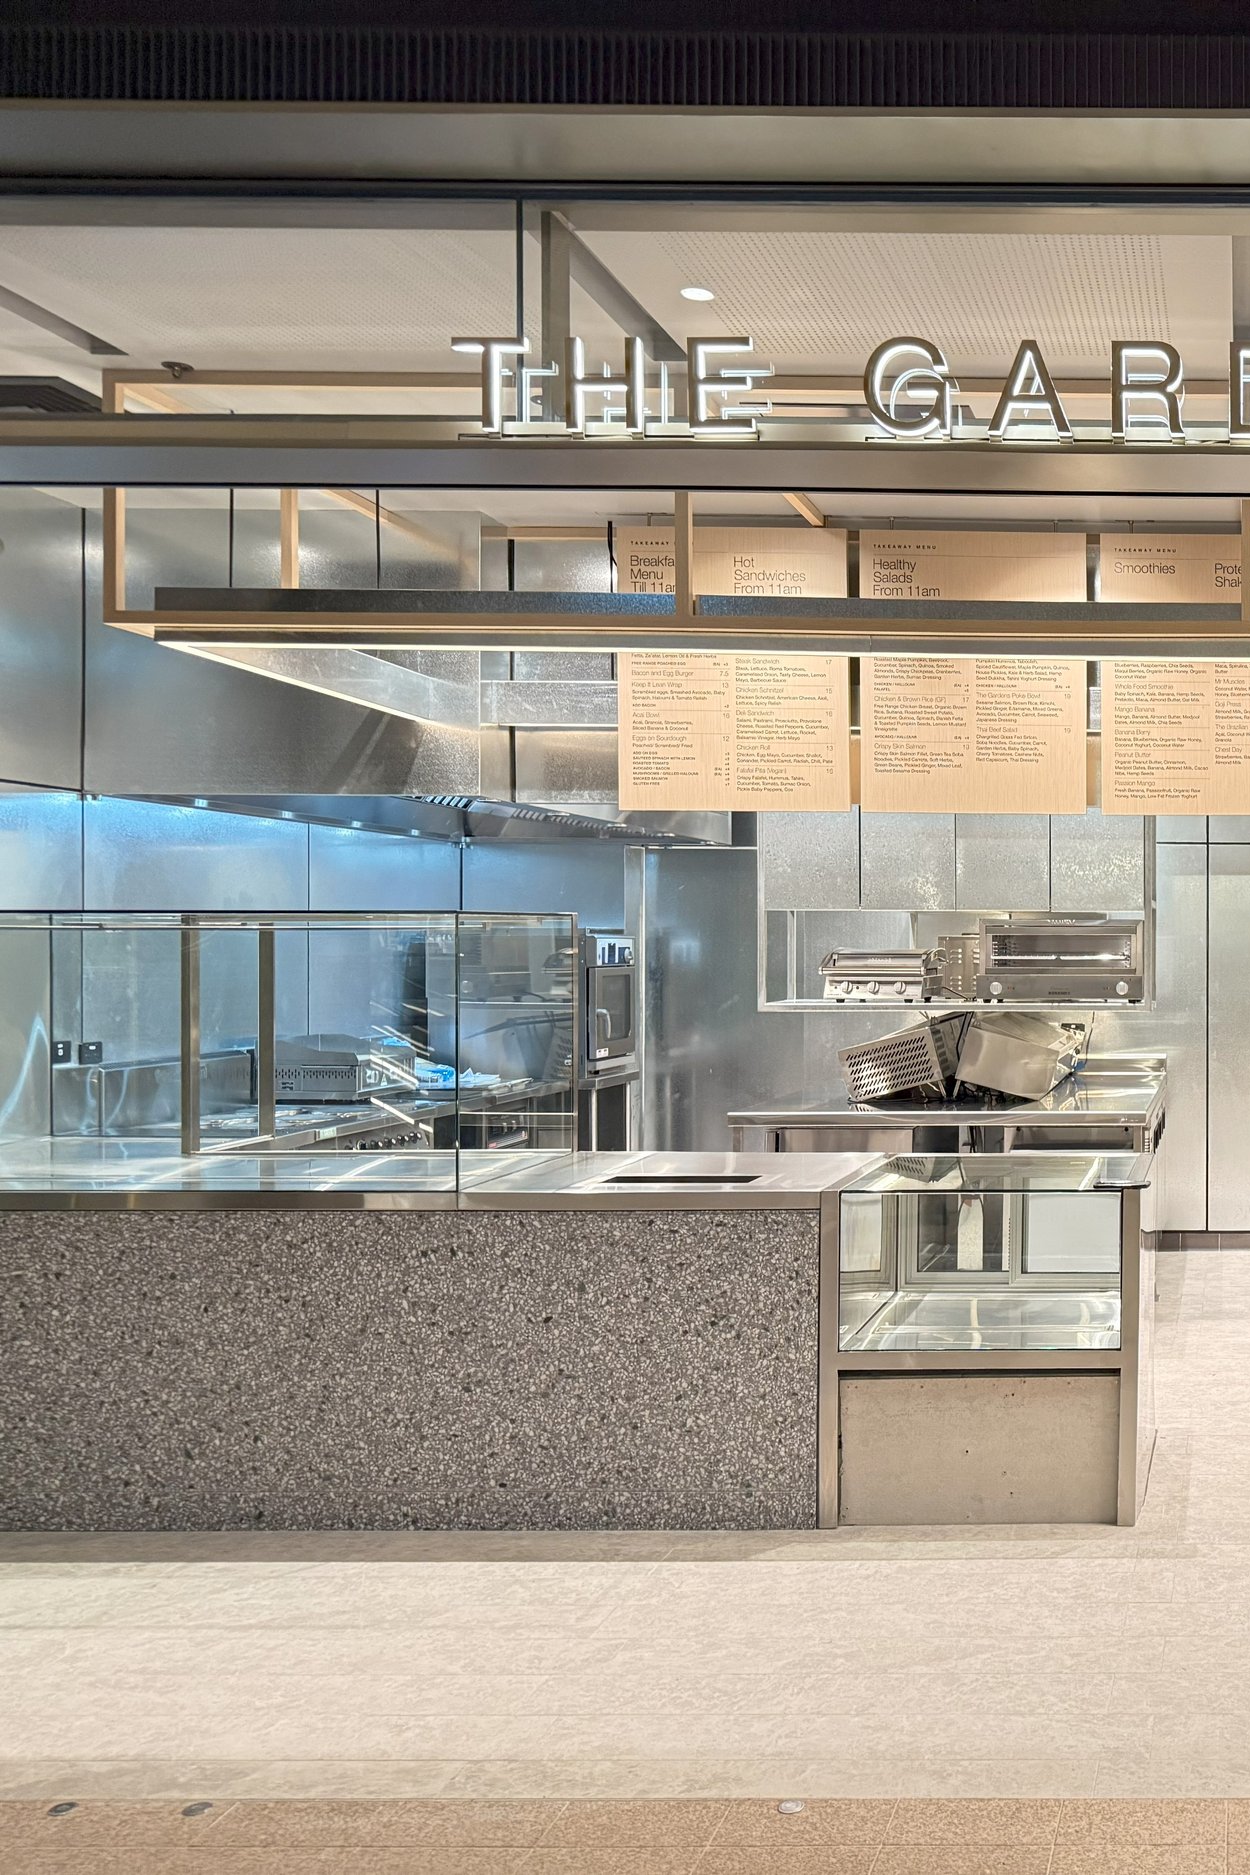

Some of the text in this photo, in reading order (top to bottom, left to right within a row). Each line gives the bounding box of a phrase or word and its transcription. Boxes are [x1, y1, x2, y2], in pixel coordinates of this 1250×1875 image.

[451, 336, 759, 438] THE
[630, 555, 675, 567] Breakfa
[733, 556, 754, 568] Hot
[873, 559, 916, 572] Healthy
[1114, 562, 1176, 574] Smoothies
[1214, 563, 1242, 575] Prote
[630, 569, 664, 580] Menu
[734, 569, 806, 581] Sandwiches
[873, 572, 913, 583] Salads
[631, 582, 675, 593] Till 11a
[734, 583, 802, 594] From 11am
[873, 585, 940, 596] From 11am
